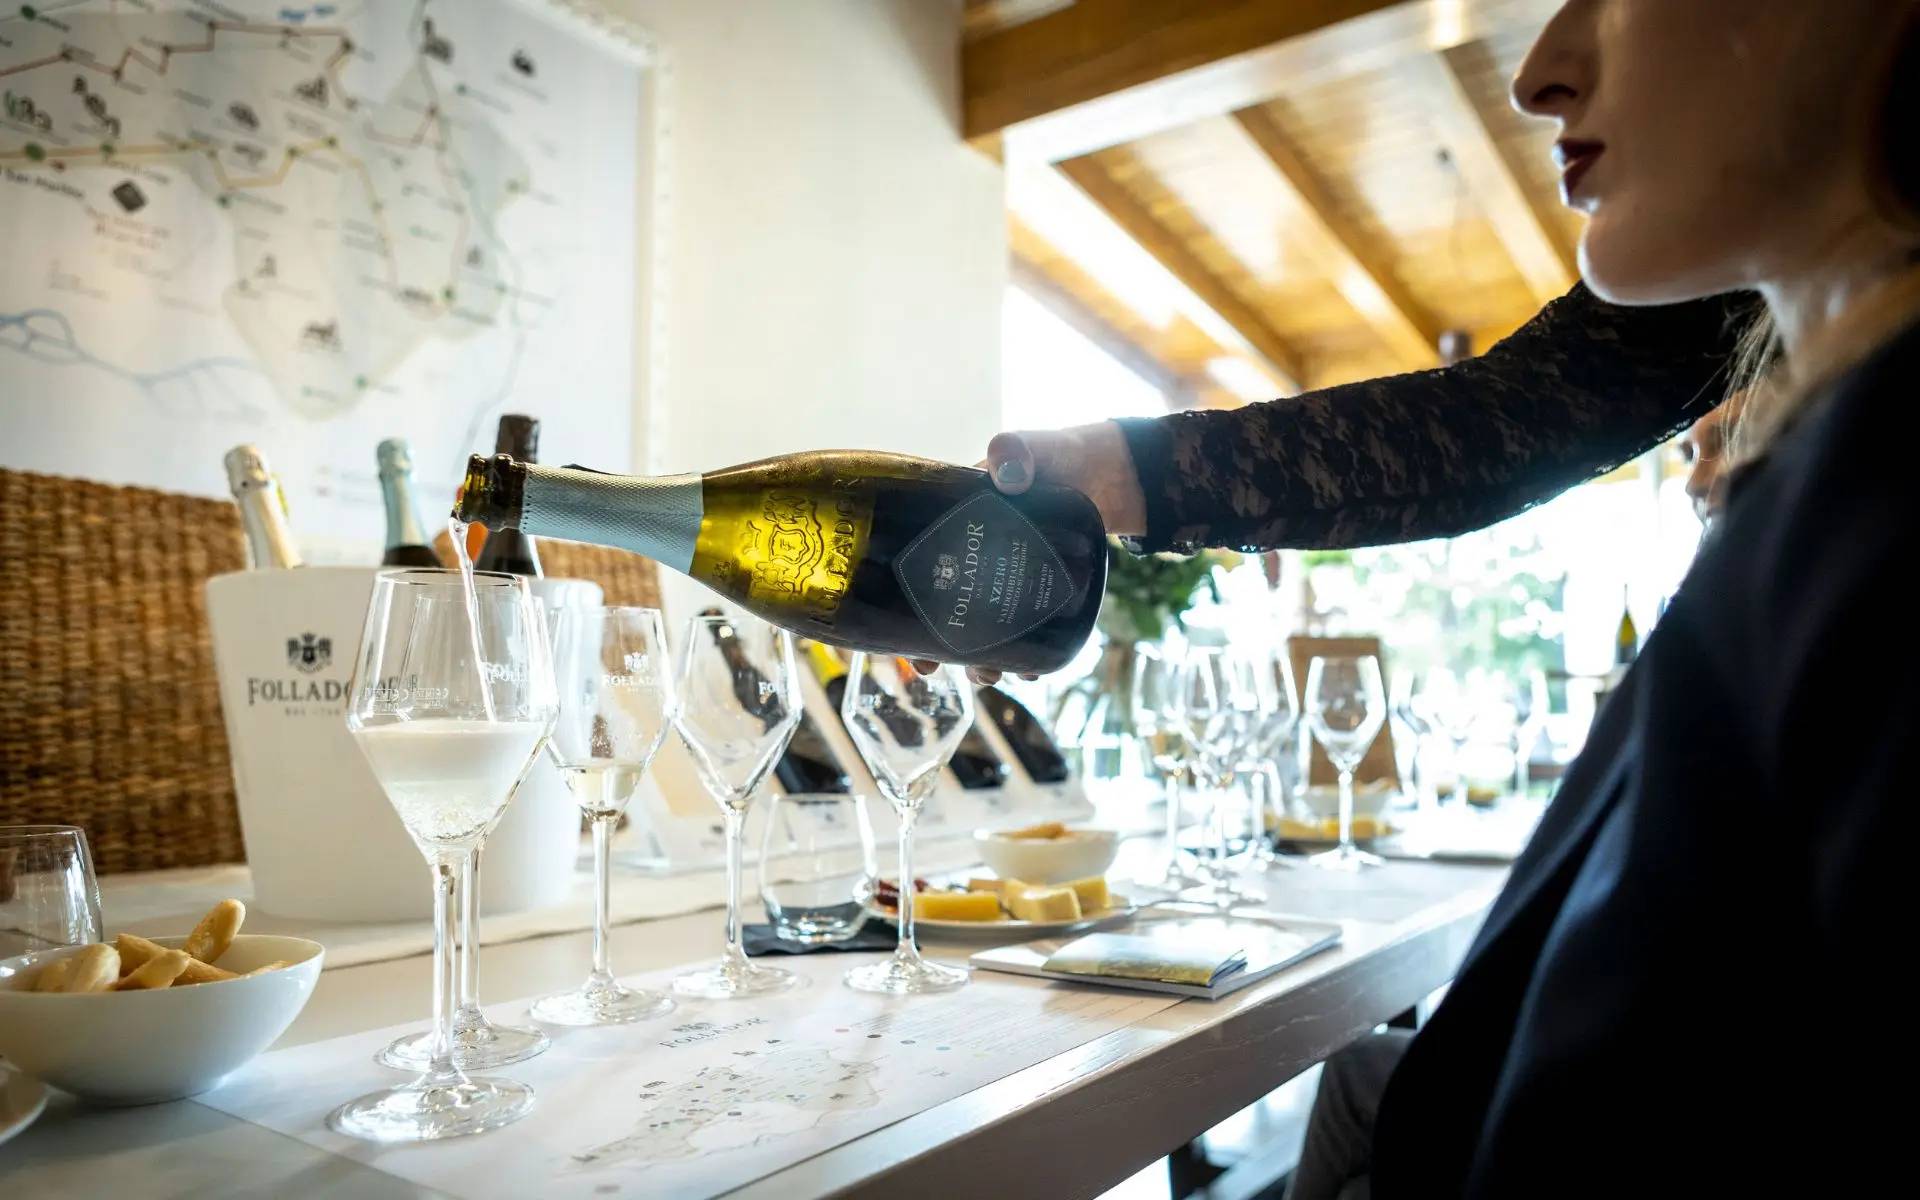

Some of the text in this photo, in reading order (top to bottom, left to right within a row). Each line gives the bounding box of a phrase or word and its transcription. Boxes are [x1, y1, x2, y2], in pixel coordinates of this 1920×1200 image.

[947, 521, 984, 629] FOLLADOR
[990, 557, 1007, 604] XZERO
[248, 677, 355, 707] FOLLAD
